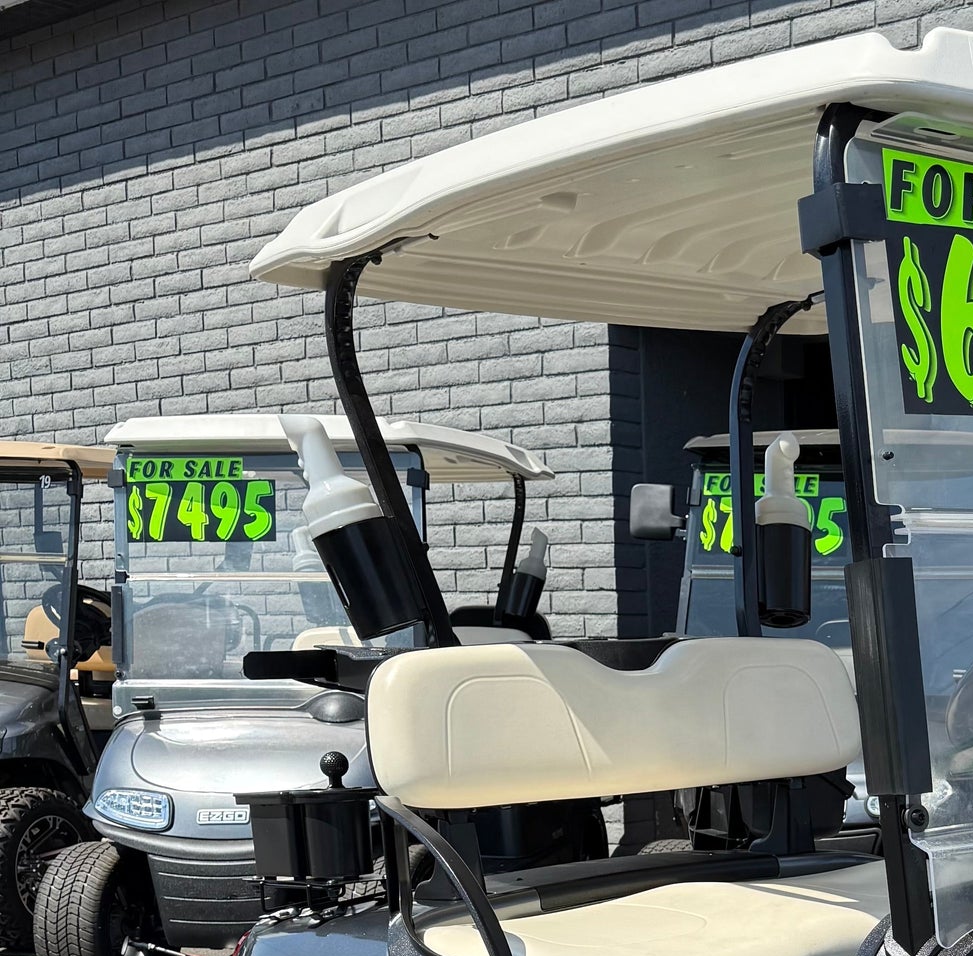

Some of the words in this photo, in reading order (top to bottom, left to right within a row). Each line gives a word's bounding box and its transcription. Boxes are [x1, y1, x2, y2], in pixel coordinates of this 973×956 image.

[129, 459, 173, 479] FOR
[183, 459, 242, 479] SALE
[39, 475, 51, 489] 19
[707, 474, 731, 492] FO
[127, 481, 274, 541] $7495
[700, 497, 847, 556] $75
[199, 810, 248, 822] EZGO
